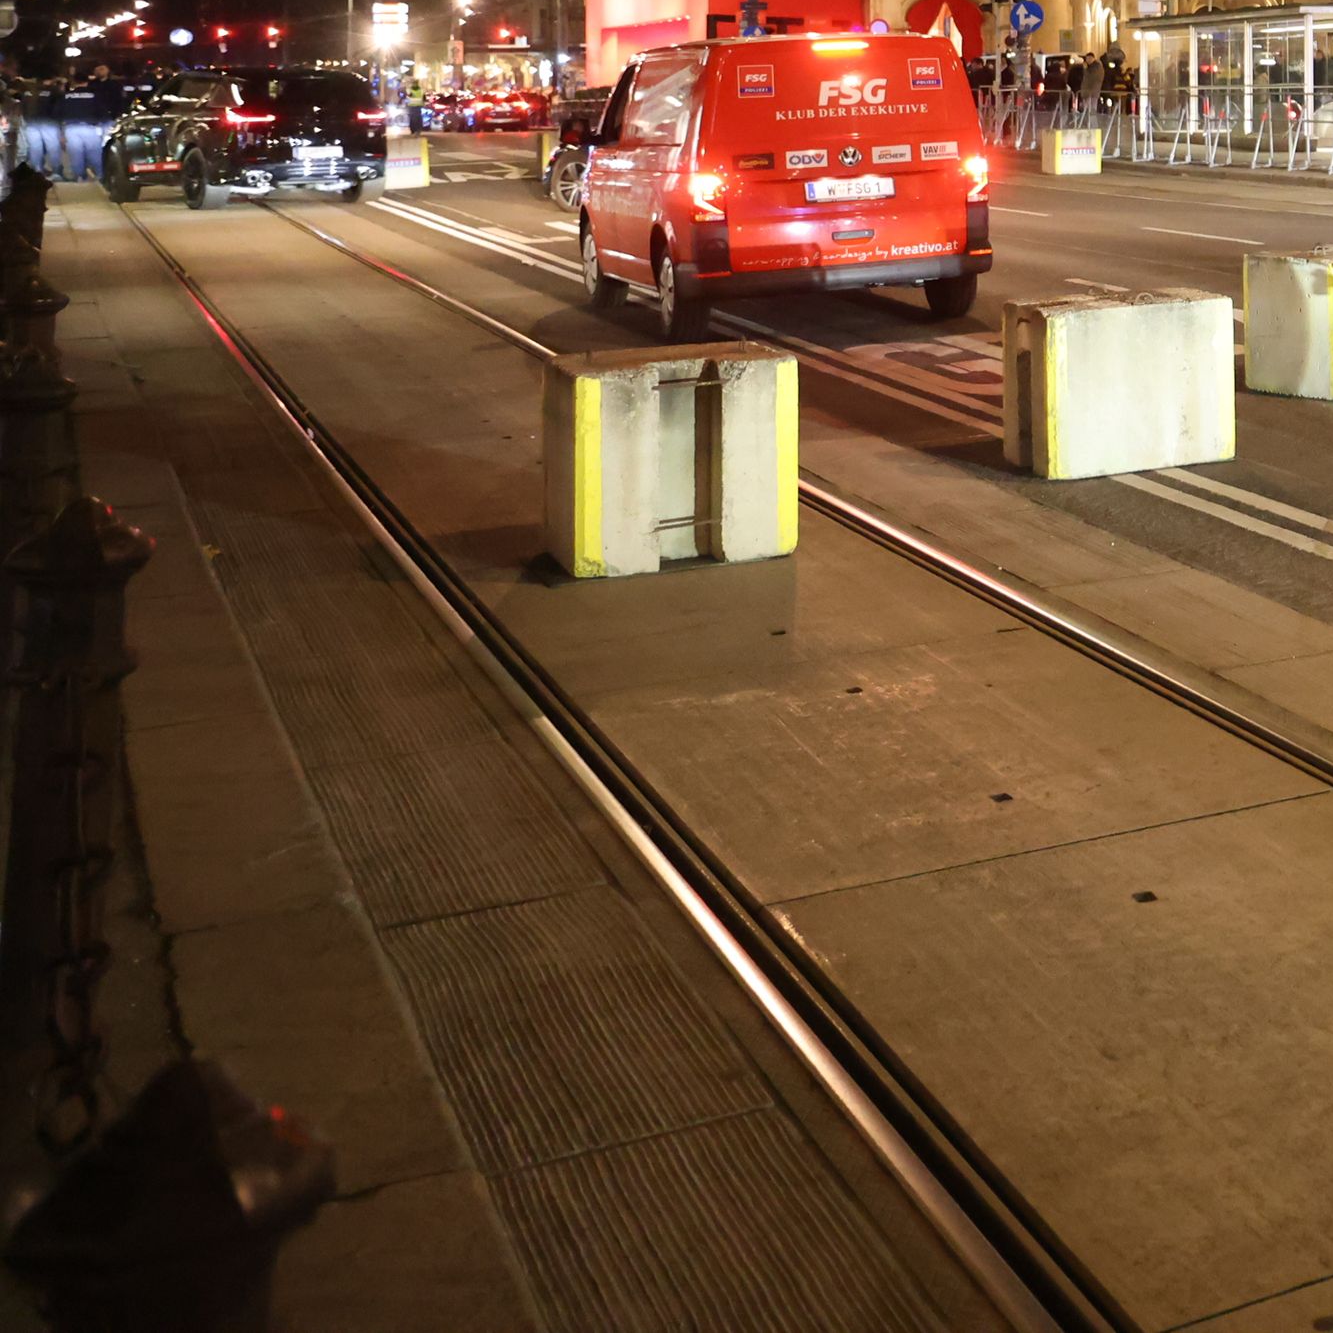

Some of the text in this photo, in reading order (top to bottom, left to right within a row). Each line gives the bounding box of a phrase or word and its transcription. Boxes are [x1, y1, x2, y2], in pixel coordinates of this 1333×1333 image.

[915, 67, 935, 75] FSG
[745, 74, 767, 83] FSG
[818, 78, 887, 106] FSG
[776, 103, 928, 120] KLUB DER EXEKUTIVE
[923, 145, 939, 154] VAV
[828, 181, 881, 195] W FSG 1
[891, 240, 958, 257] kreativo.at
